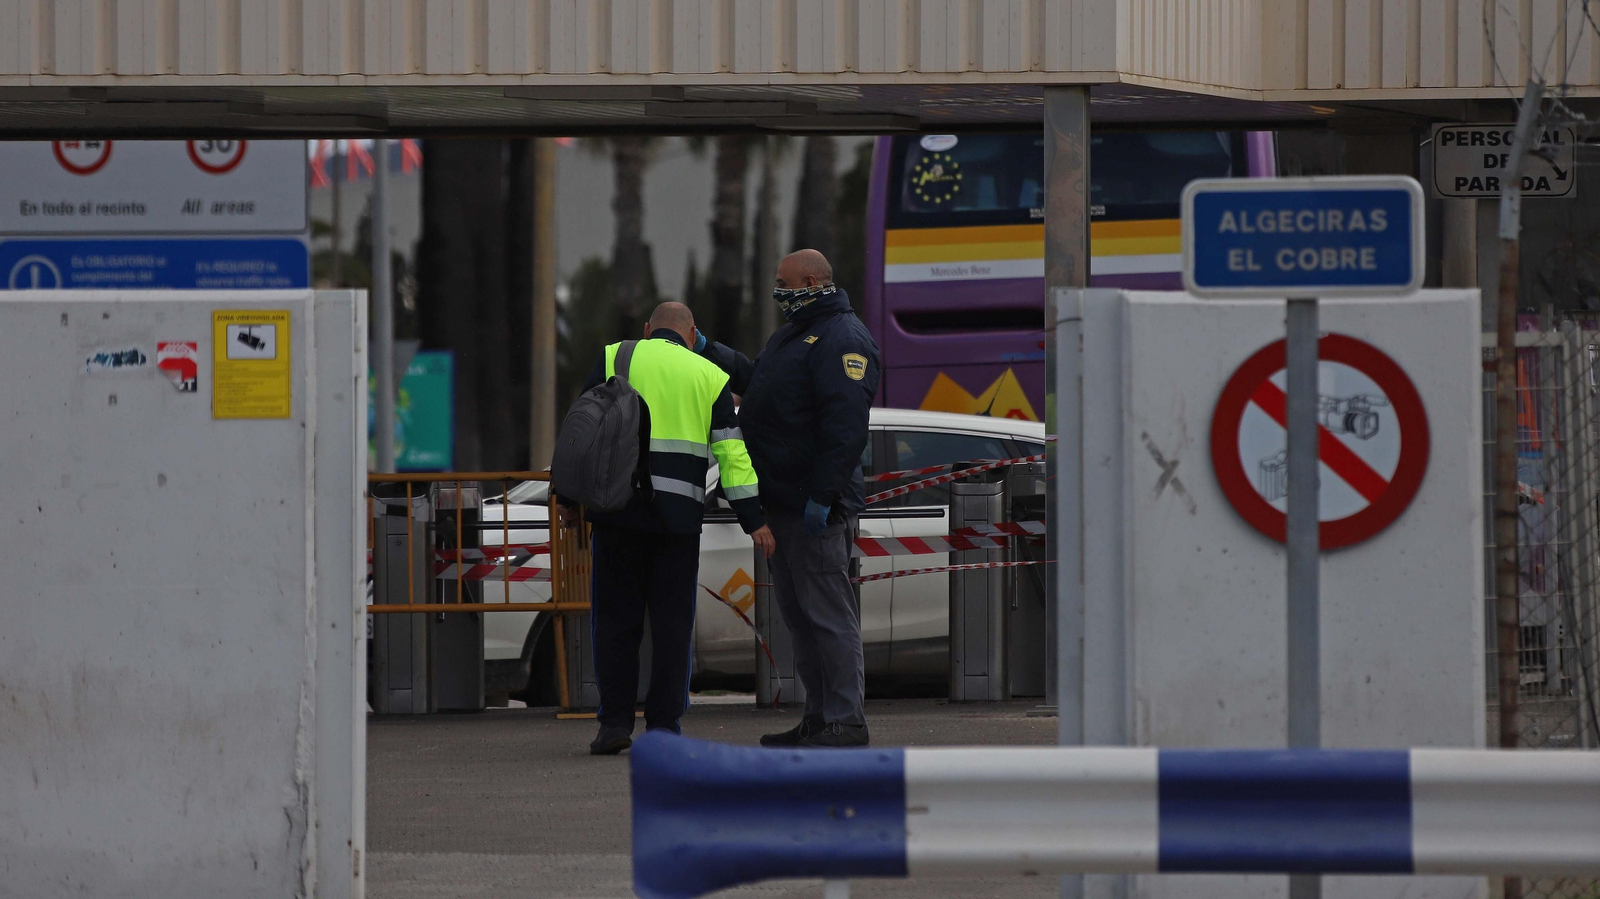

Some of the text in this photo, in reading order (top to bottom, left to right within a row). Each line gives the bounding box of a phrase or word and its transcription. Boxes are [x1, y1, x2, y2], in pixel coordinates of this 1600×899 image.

[1441, 130, 1566, 147] PERSOAL
[1454, 176, 1552, 192] PARDA
[19, 200, 146, 216] En todo el recinto
[181, 198, 255, 215] All areas
[1218, 207, 1389, 233] ALGECIRAS
[1228, 246, 1377, 272] EL COBRE
[931, 265, 991, 277] Mercedes Benz
